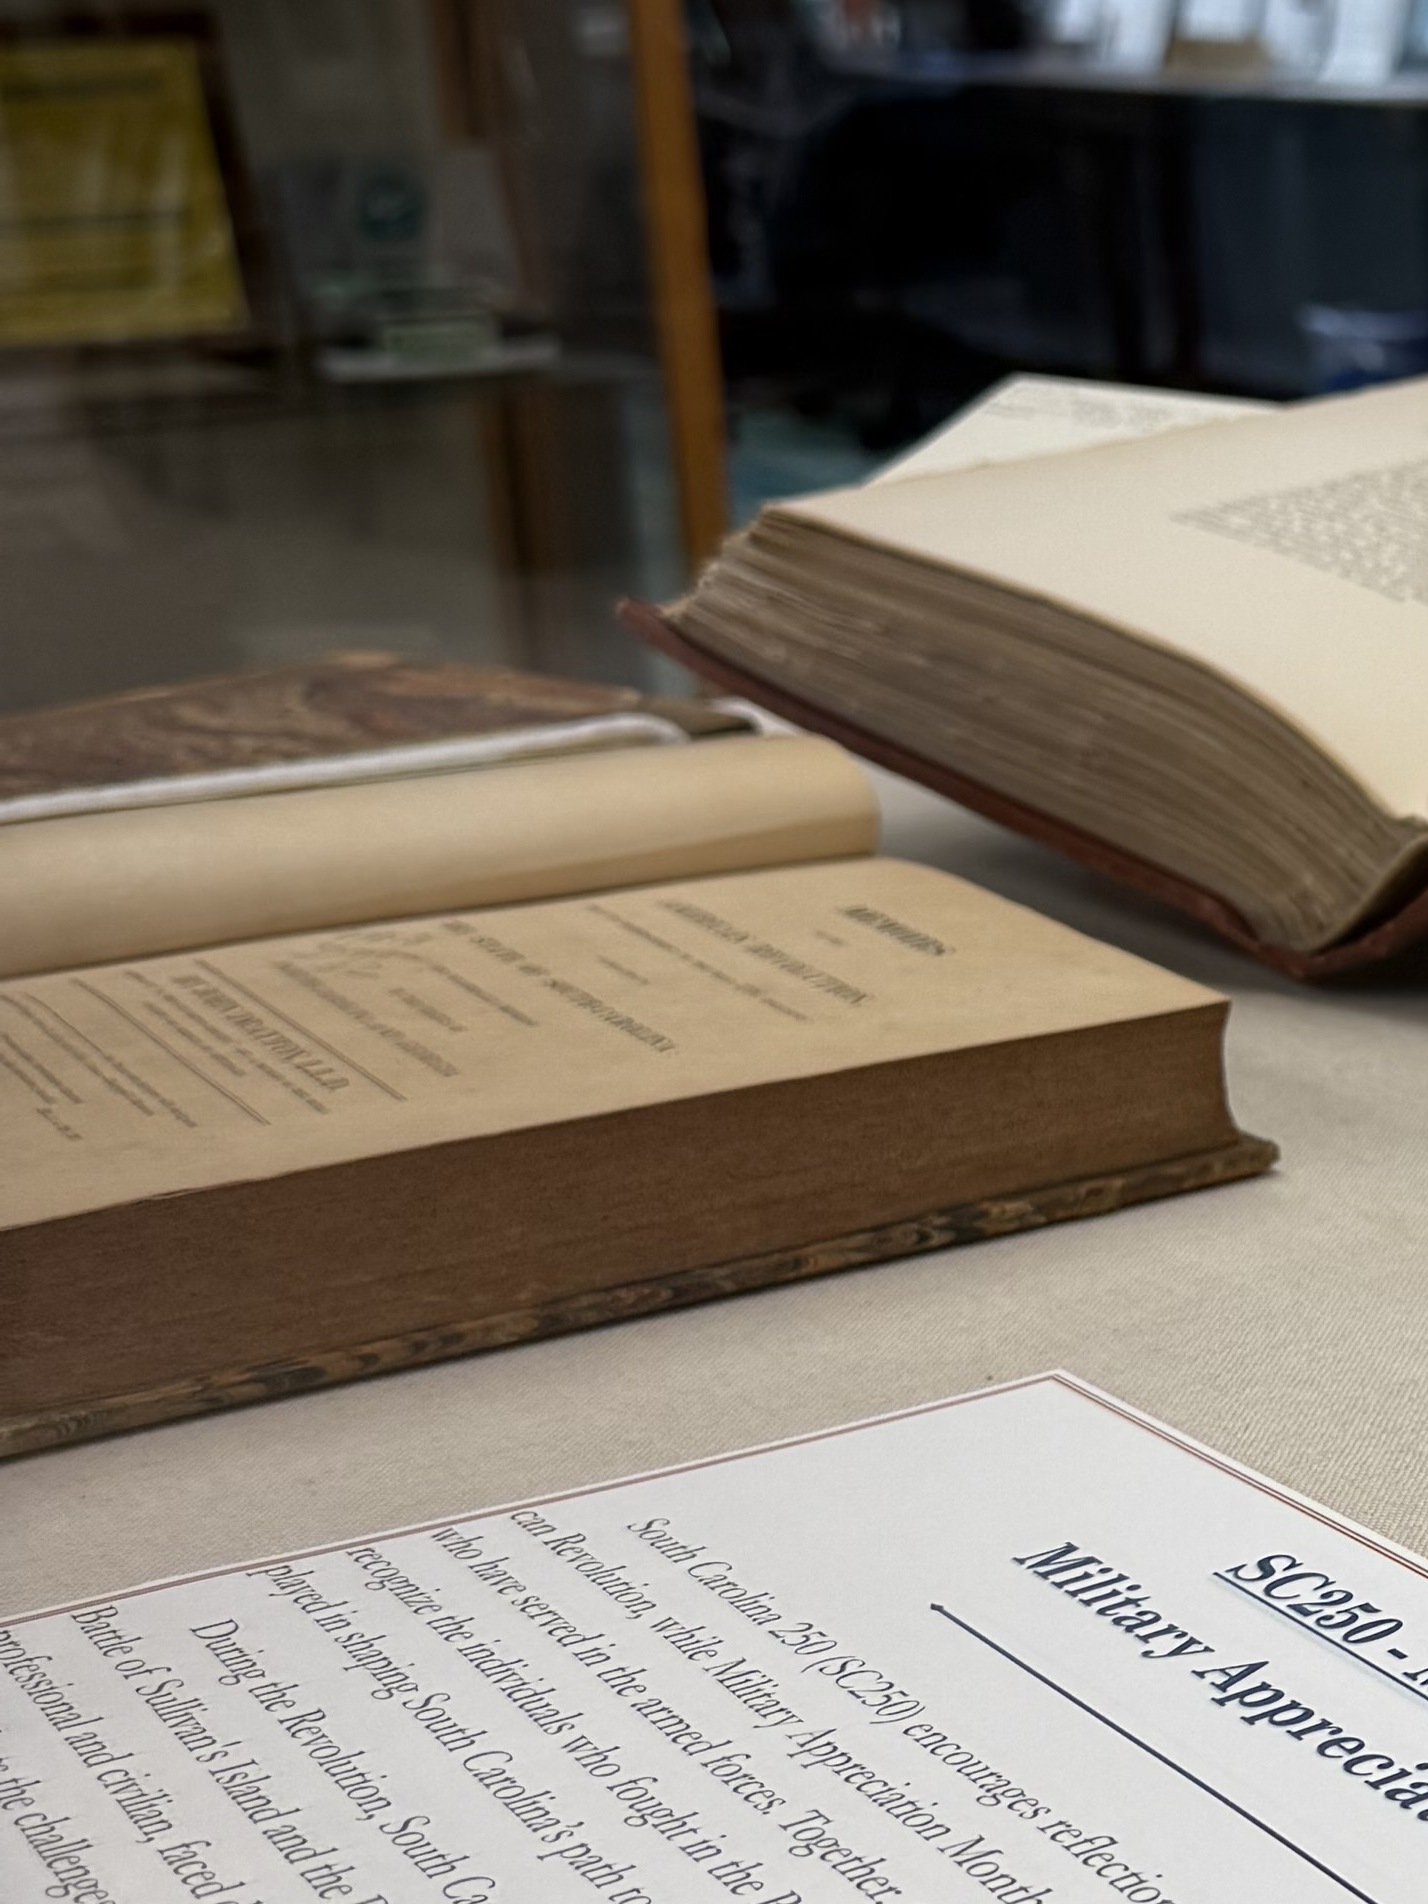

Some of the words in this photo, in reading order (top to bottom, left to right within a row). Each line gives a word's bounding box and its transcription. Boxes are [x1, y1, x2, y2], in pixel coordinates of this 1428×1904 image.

[624, 1516, 710, 1566] South
[243, 1563, 352, 1617] played
[311, 1608, 360, 1635] in
[685, 1559, 784, 1628] Carolina
[1009, 1540, 1217, 1661] Military
[1222, 1552, 1405, 1646] SC250
[332, 1630, 421, 1702] shaping
[428, 1525, 486, 1562] who
[465, 1554, 529, 1597] have
[508, 1593, 608, 1650] served
[570, 1641, 618, 1670] in
[594, 1664, 650, 1699] the
[628, 1696, 735, 1758] armed
[698, 1751, 789, 1817] forces.
[507, 1500, 559, 1539] can
[539, 1530, 659, 1622] Revolution,
[647, 1614, 726, 1663] while
[700, 1655, 806, 1731] Military
[783, 1726, 953, 1843] Appreciation
[765, 1620, 840, 1657] 250
[187, 1616, 268, 1688] During
[245, 1680, 302, 1714] the
[275, 1706, 394, 1823] Revolution,
[343, 1545, 445, 1617] recognize
[423, 1613, 477, 1645] the
[454, 1637, 586, 1737] individuals
[558, 1733, 623, 1780] who
[604, 1774, 703, 1843] fought
[676, 1832, 729, 1865] in
[705, 1858, 766, 1898] the
[399, 1690, 490, 1755] South
[798, 1653, 928, 1727] (SC250)
[460, 1748, 587, 1845] Carolina’s
[900, 1722, 1054, 1822] encourages
[534, 1840, 639, 1891] path
